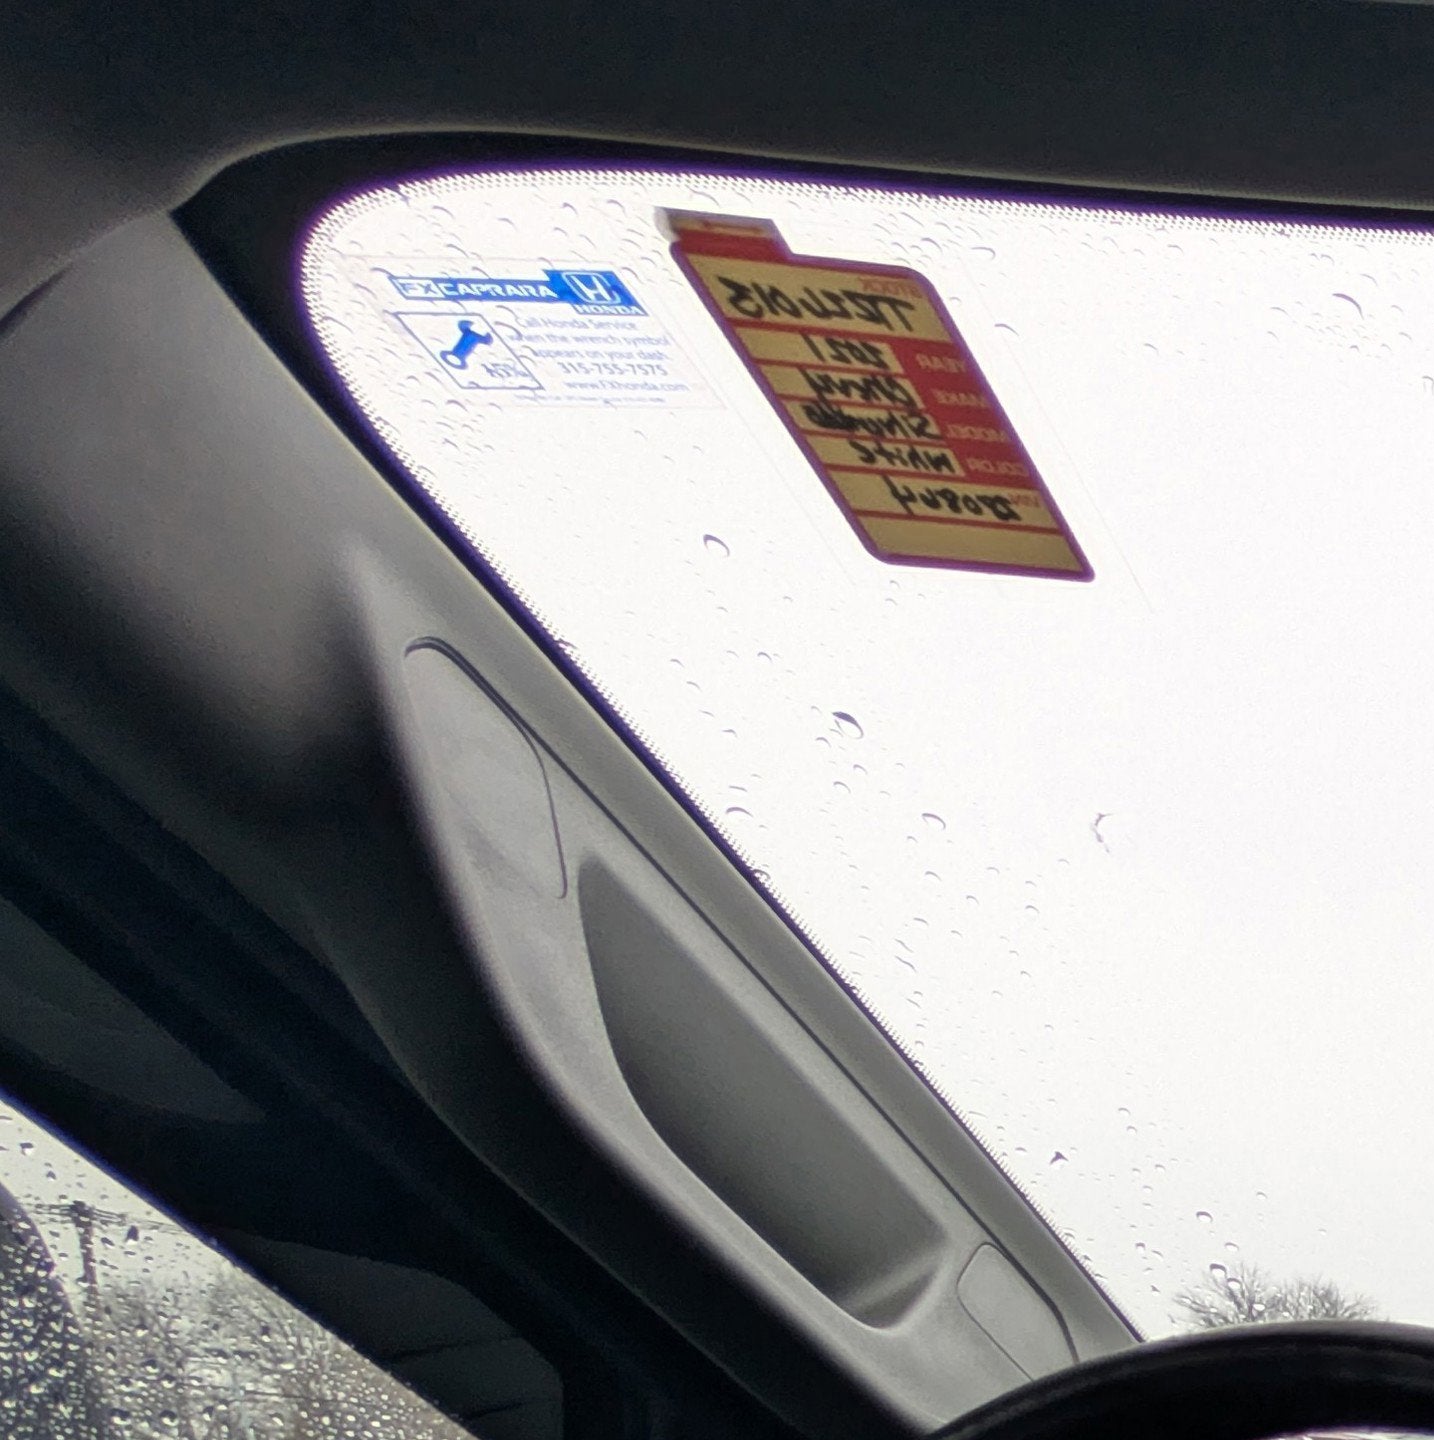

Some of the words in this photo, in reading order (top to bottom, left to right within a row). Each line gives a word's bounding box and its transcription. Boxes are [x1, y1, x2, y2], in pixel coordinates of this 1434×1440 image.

[437, 281, 559, 298] CAPRARA
[574, 303, 646, 315] HONDA
[543, 318, 586, 330] Honda
[589, 319, 636, 331] Service
[606, 351, 634, 361] your
[556, 361, 668, 376] 315-755-7575
